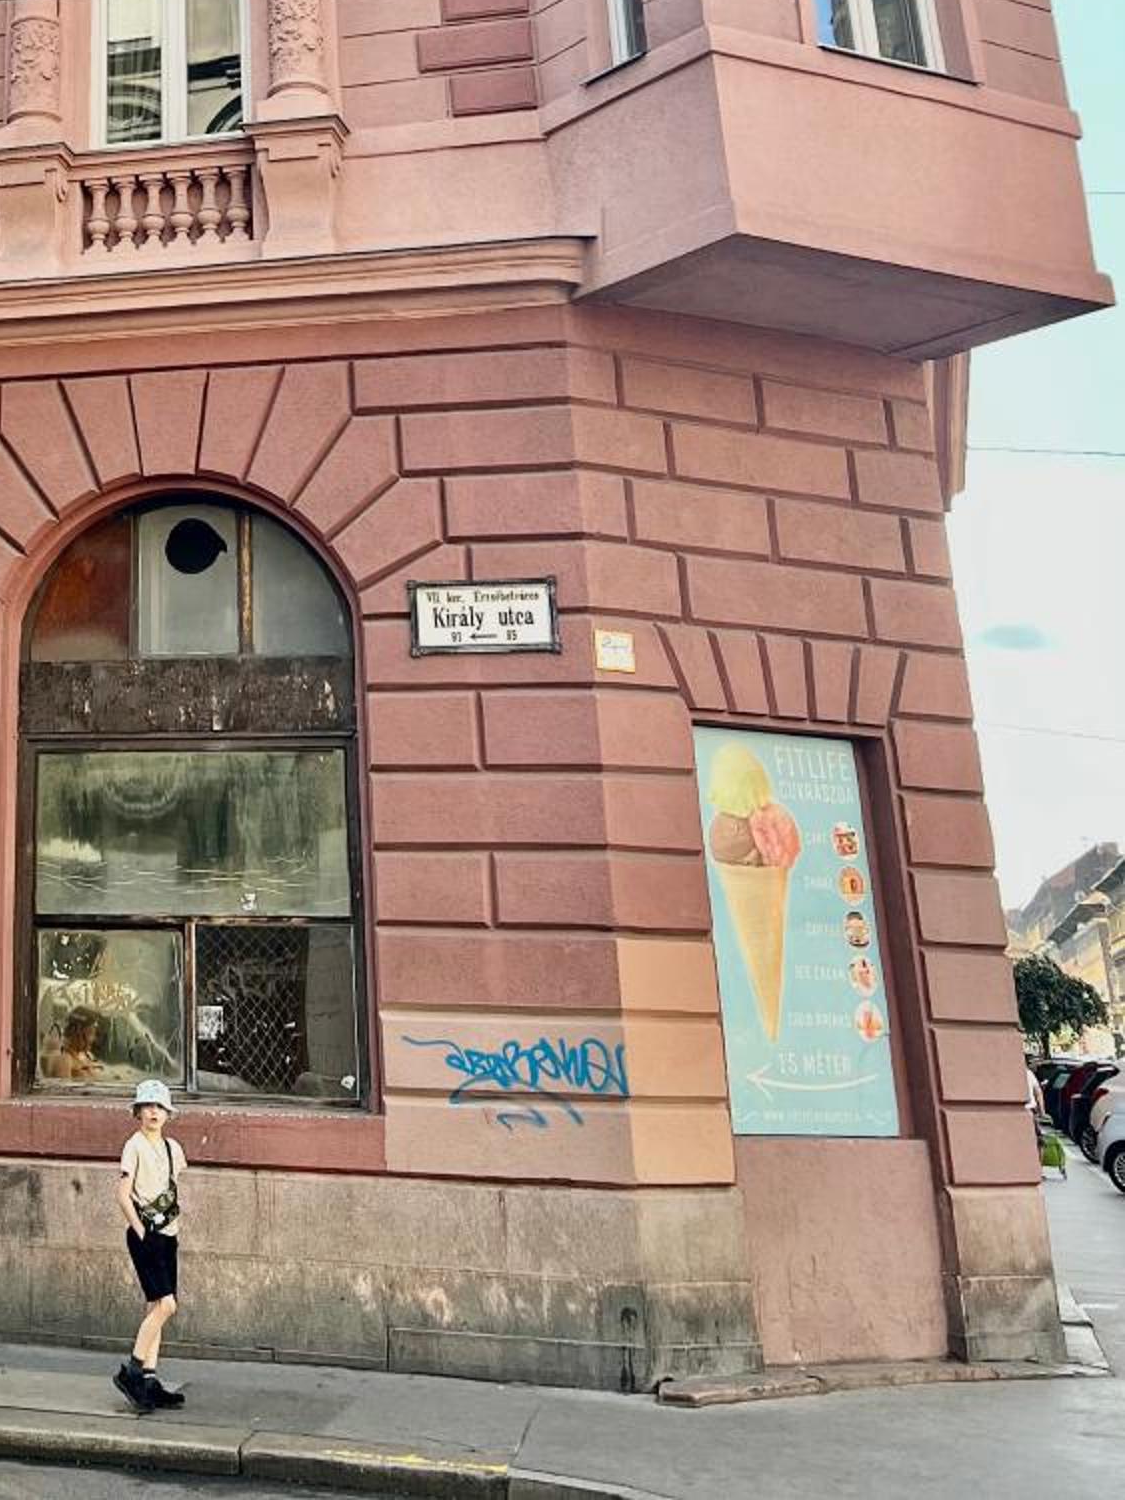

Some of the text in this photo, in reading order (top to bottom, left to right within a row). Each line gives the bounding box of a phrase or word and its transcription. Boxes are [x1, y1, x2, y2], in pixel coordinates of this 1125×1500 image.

[433, 606, 534, 631] Király utca
[775, 746, 851, 780] FITLIFE
